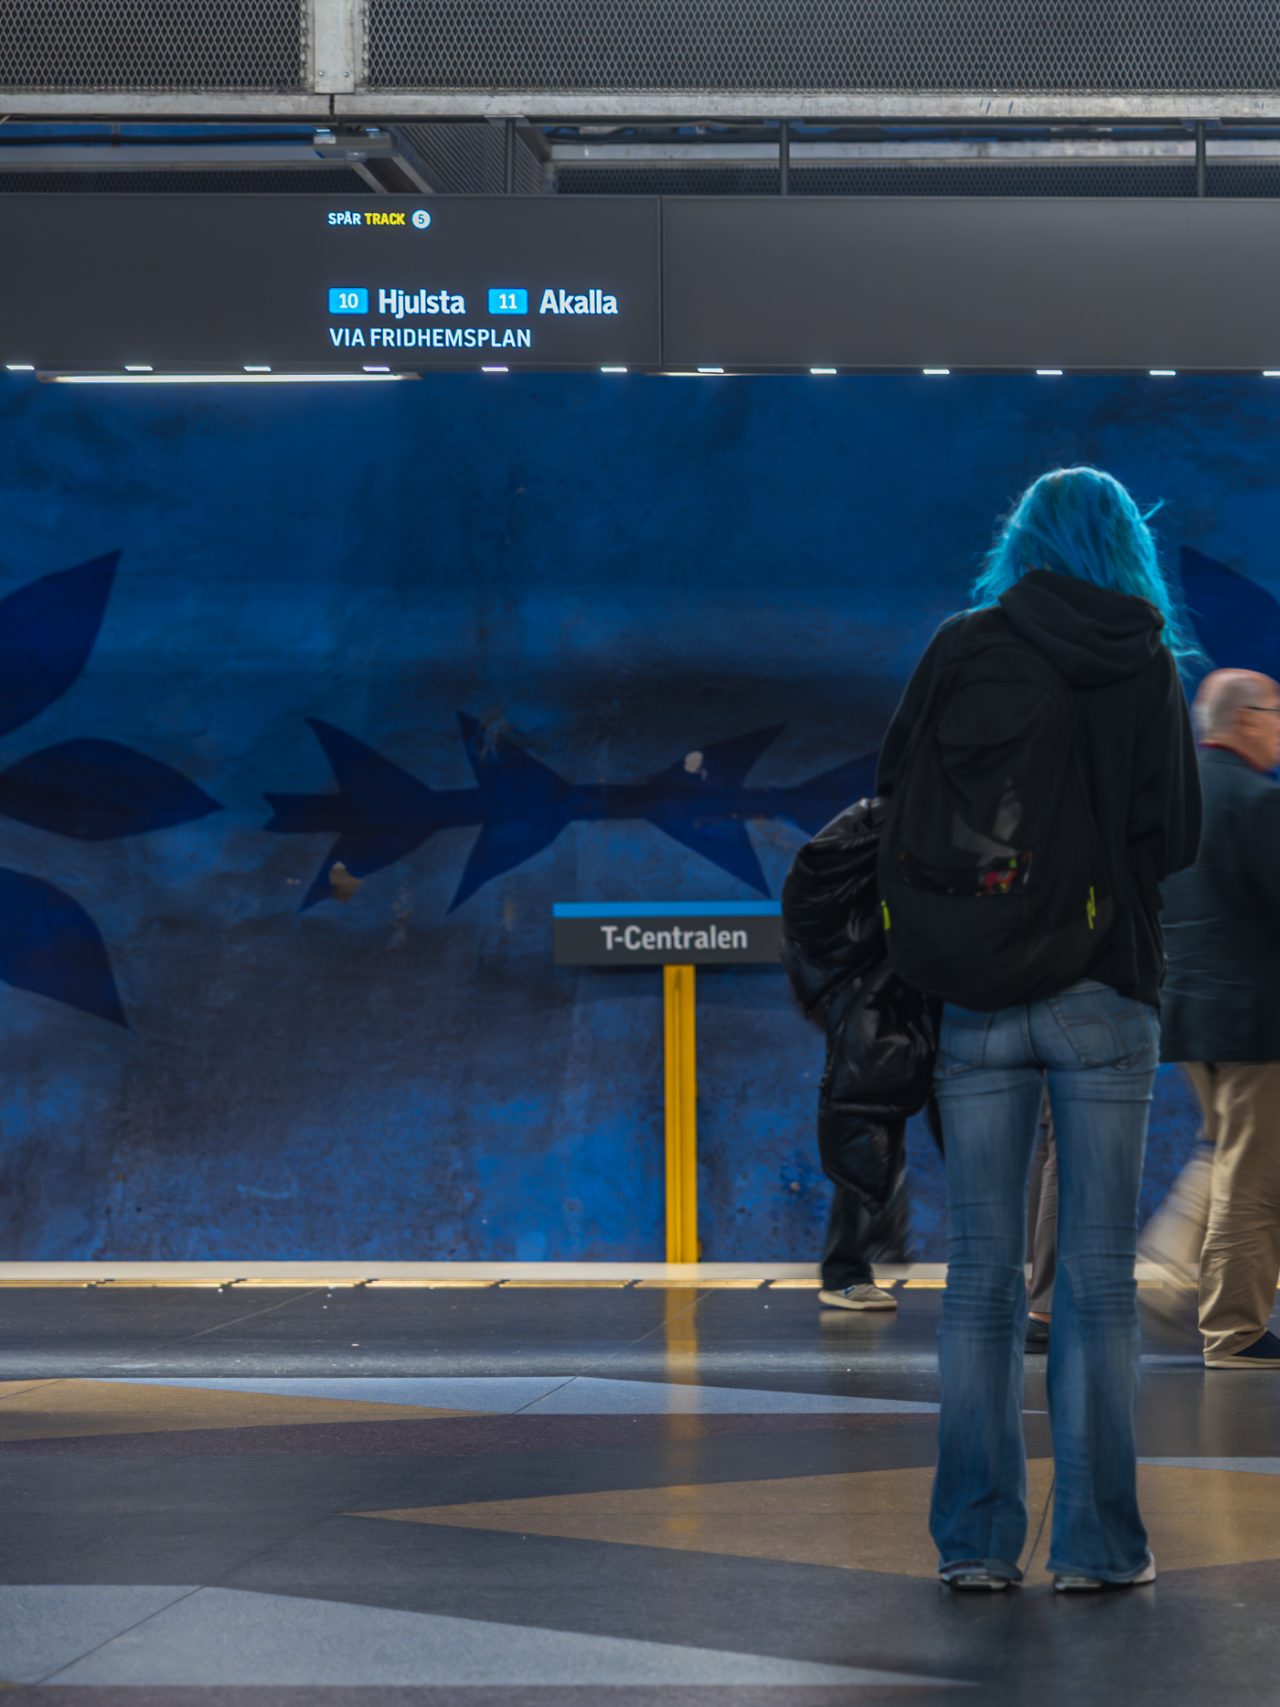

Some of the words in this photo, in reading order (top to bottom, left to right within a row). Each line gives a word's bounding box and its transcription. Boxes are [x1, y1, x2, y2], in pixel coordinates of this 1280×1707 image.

[328, 211, 361, 225] SPÅR
[364, 212, 406, 225] TRACK
[417, 214, 425, 224] 5
[338, 293, 359, 309] 10
[378, 288, 467, 319] Hjulsta
[498, 293, 518, 309] 11
[539, 288, 619, 314] Akalla
[329, 328, 366, 347] VIA
[370, 328, 532, 347] FRIDHEMSPLAN
[600, 924, 748, 951] T-Centralen
